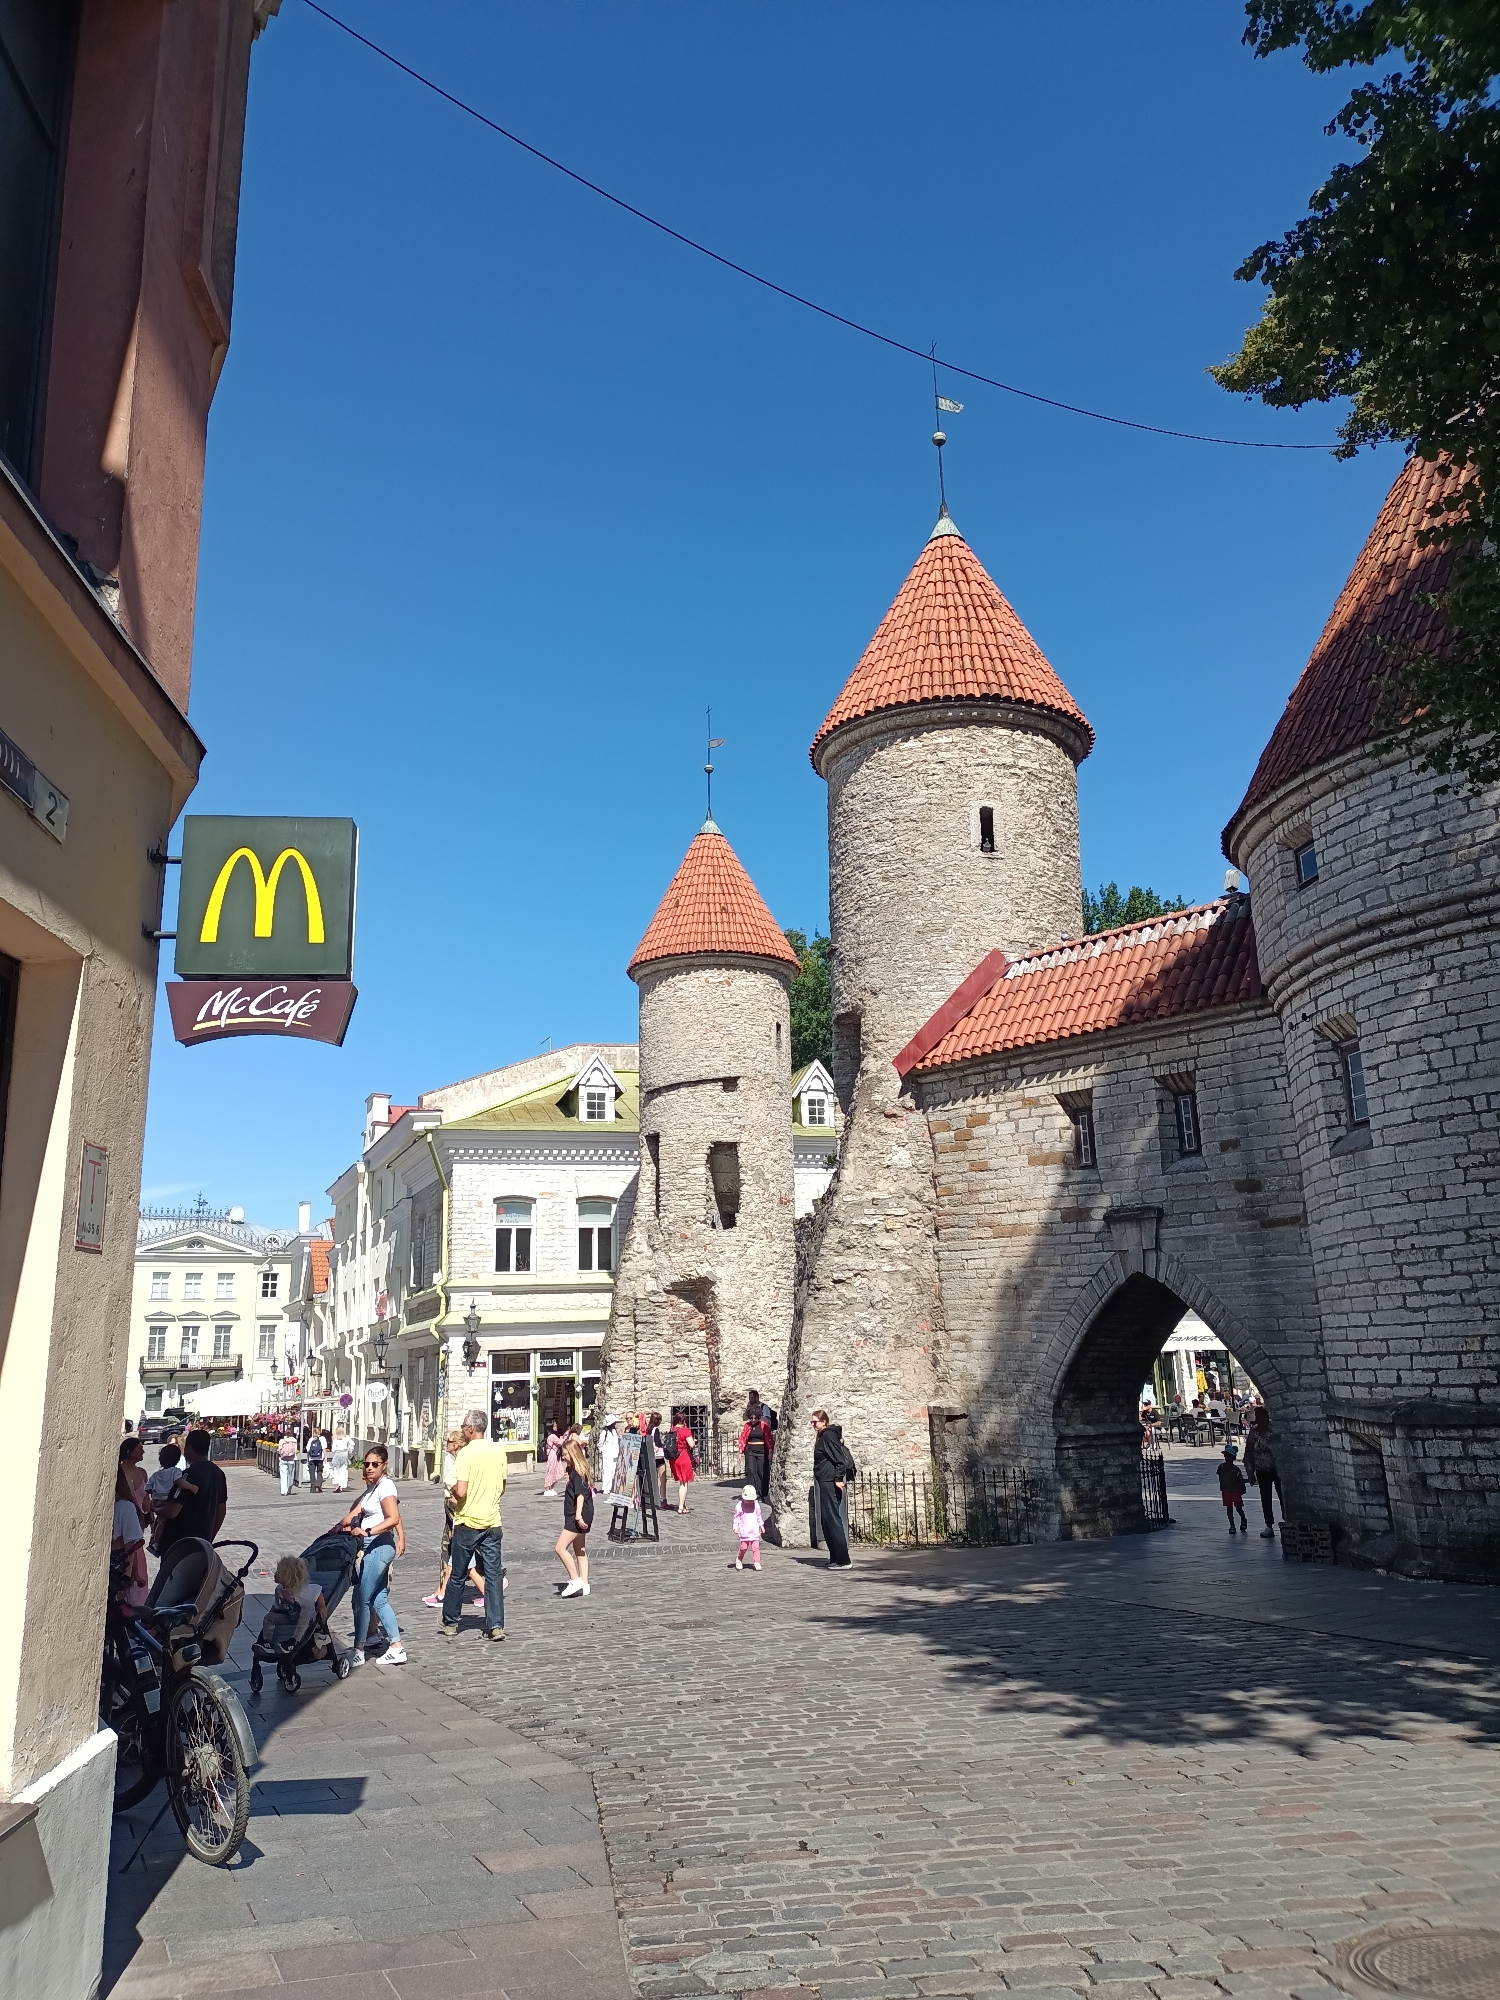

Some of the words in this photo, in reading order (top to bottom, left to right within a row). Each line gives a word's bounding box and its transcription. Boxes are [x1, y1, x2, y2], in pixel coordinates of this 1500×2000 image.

[0, 743, 20, 779] lli
[45, 791, 58, 827] 2
[196, 985, 321, 1028] McCafé
[539, 1358, 558, 1367] oma
[558, 1356, 572, 1366] asi
